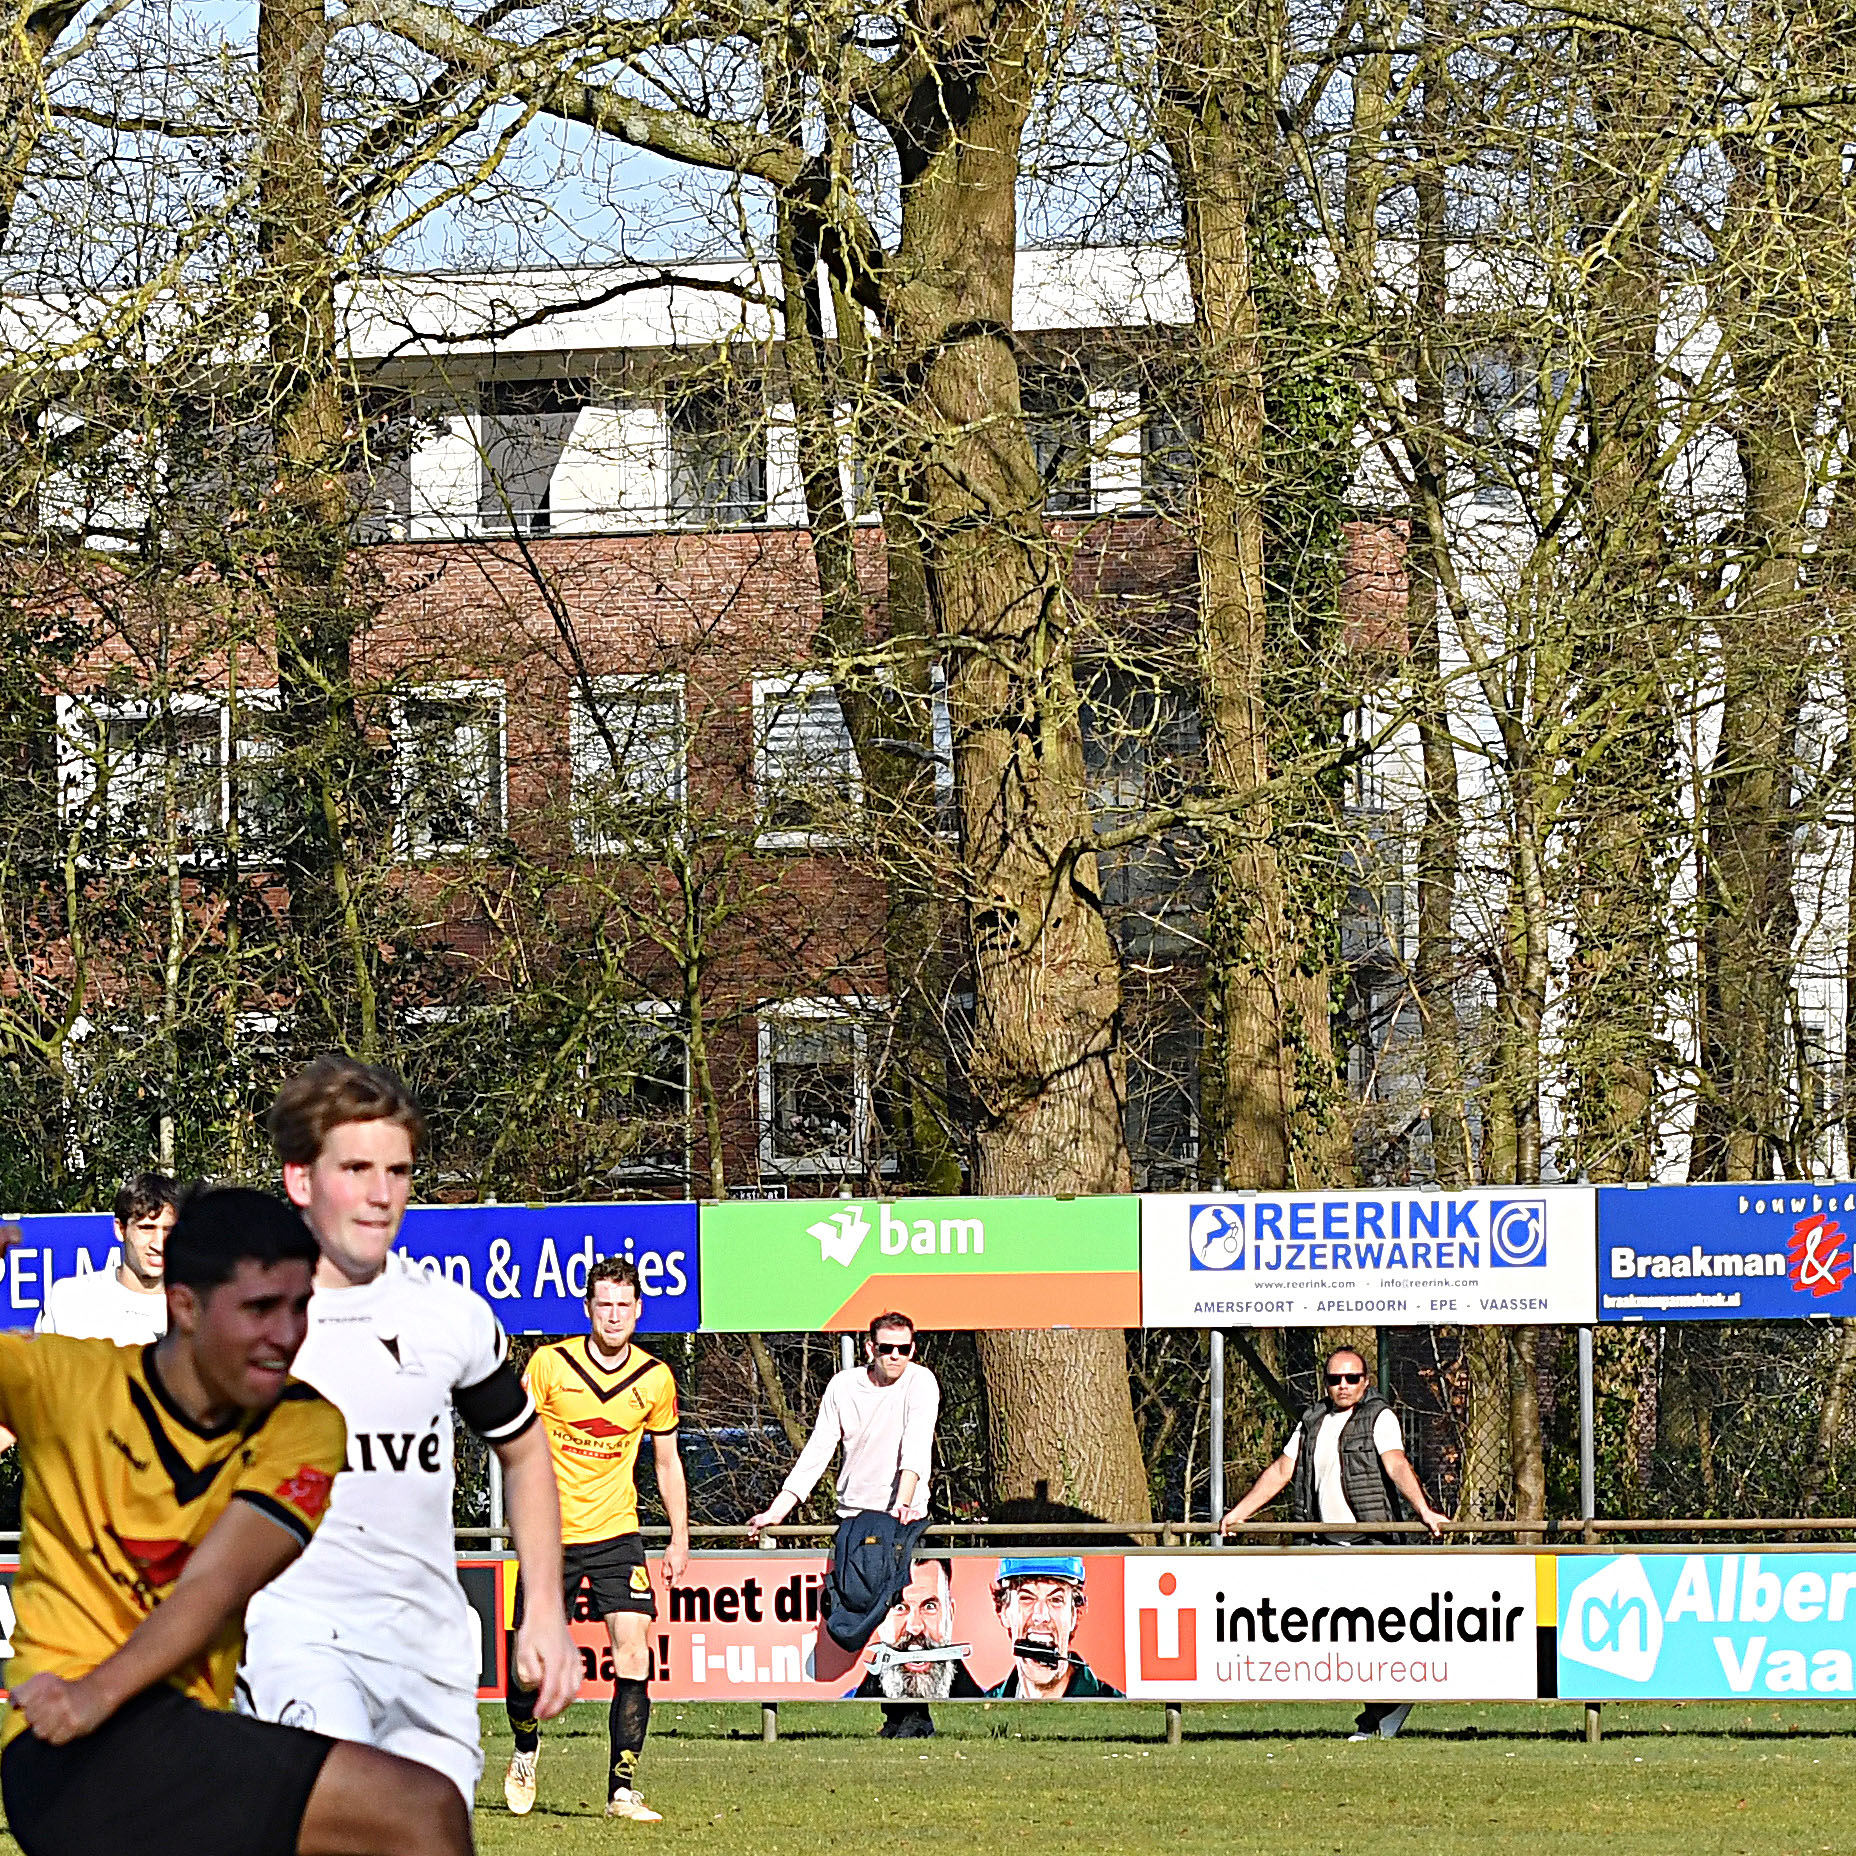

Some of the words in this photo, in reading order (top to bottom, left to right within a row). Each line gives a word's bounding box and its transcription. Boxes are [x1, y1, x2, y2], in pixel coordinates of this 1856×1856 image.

[879, 1204, 985, 1256] bam
[1253, 1199, 1480, 1241] REERINK
[485, 1238, 521, 1300] &
[533, 1235, 687, 1299] Ades
[1253, 1241, 1480, 1271] IJZERWAREN
[1610, 1246, 1786, 1280] Braakman
[1799, 1226, 1838, 1286] &
[1193, 1299, 1294, 1314] AMERSFOORT
[1316, 1298, 1408, 1313] APELDOORN
[1429, 1298, 1458, 1312] EPE
[1479, 1297, 1549, 1311] VAASSEN
[1254, 1278, 1356, 1289] www.reerink.com
[669, 1577, 763, 1623] met
[774, 1574, 822, 1623] di
[1215, 1590, 1525, 1643] intermediair
[1216, 1652, 1449, 1683] uitzendbureau
